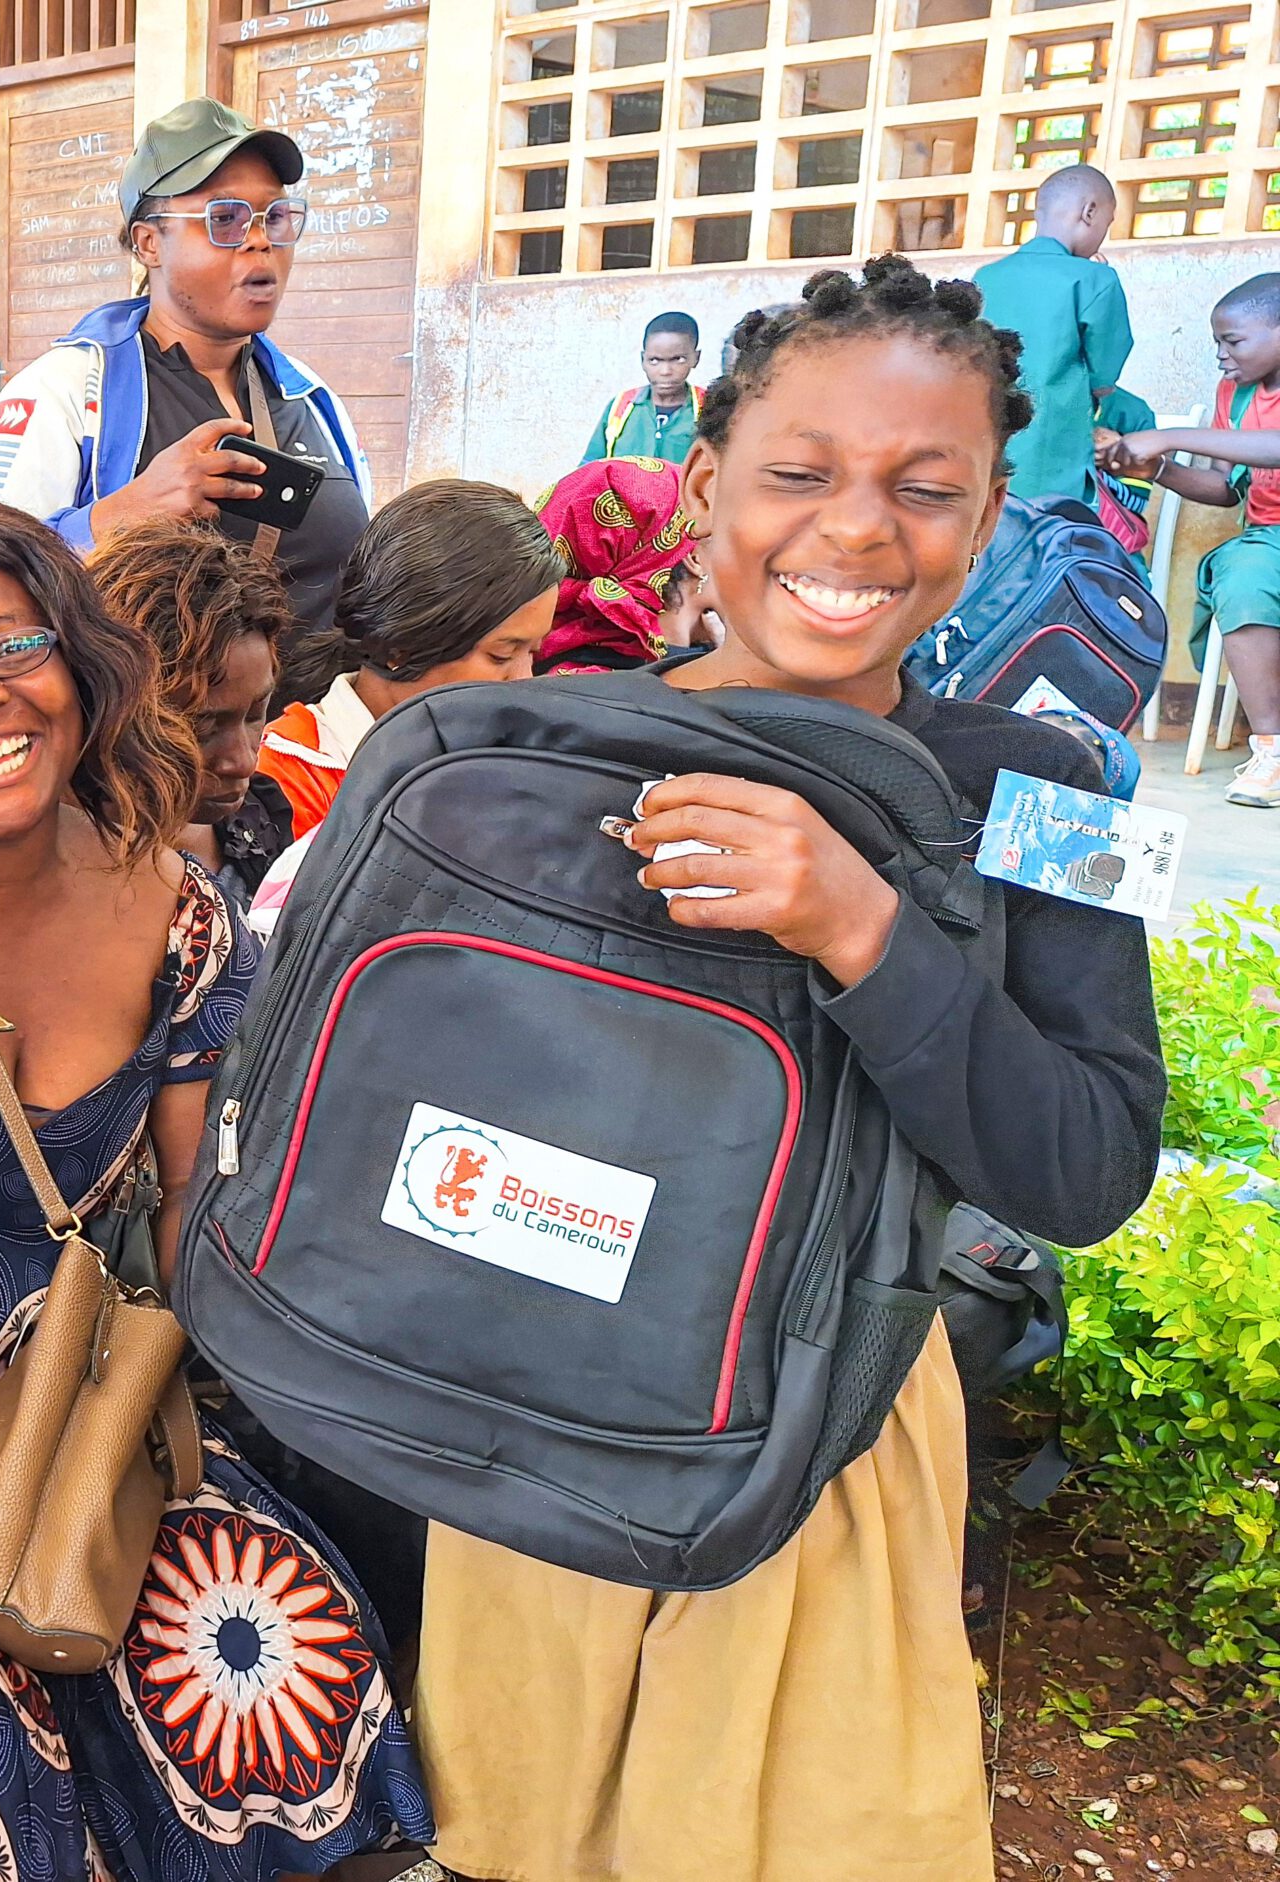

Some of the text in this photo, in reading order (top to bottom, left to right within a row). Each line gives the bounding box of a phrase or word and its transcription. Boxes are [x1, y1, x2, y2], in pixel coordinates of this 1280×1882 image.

[304, 10, 330, 27] 144
[492, 1202, 626, 1257] du Cameroun
[499, 1174, 635, 1239] Boissons
